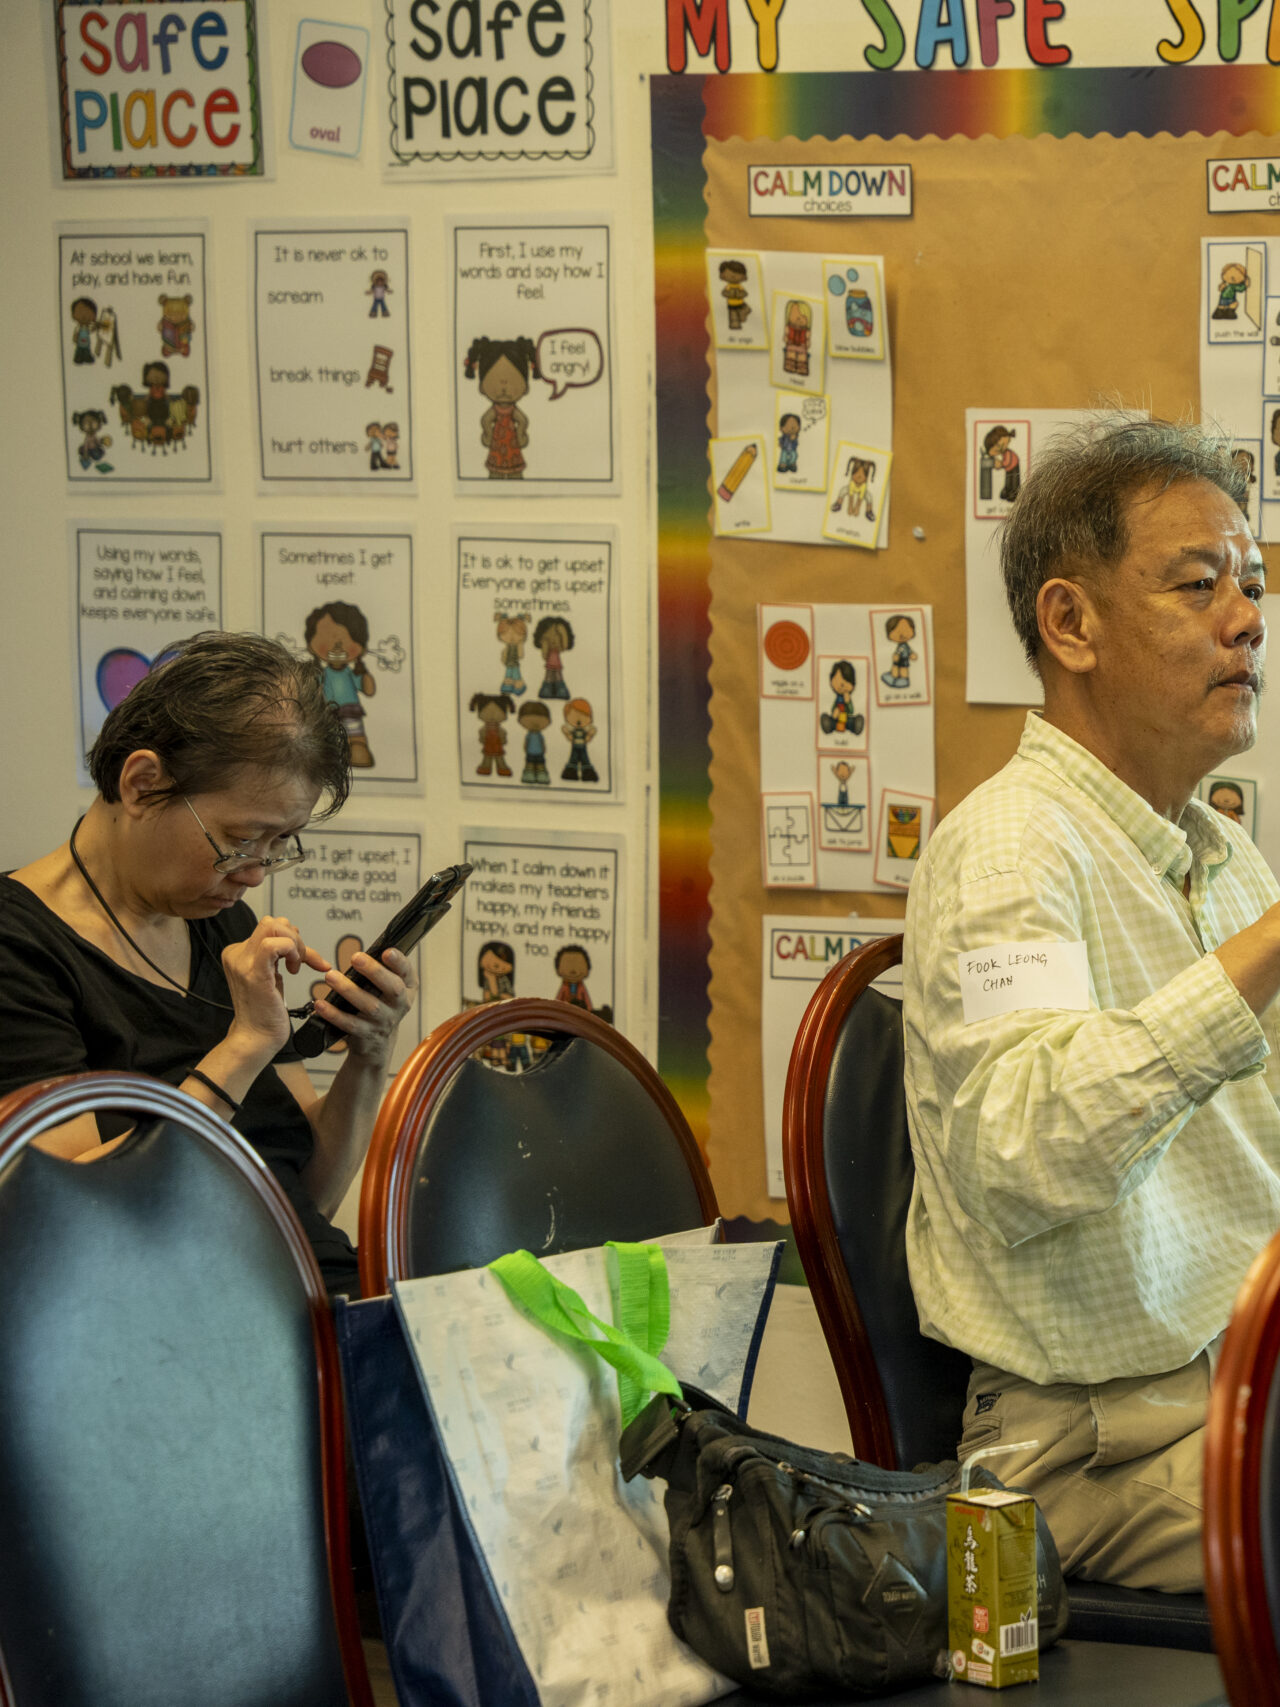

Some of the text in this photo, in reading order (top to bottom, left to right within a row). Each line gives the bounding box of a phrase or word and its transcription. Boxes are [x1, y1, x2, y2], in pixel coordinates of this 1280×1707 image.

[410, 0, 567, 61] safe
[665, 0, 787, 73] MY
[861, 0, 1072, 71] SAFE
[80, 10, 229, 75] safe
[403, 75, 577, 141] place
[75, 88, 241, 154] place
[309, 126, 341, 142] oval
[753, 169, 906, 197] CALM DOWN
[803, 198, 852, 212] choices
[71, 250, 86, 265] At
[90, 250, 132, 266] school
[136, 253, 154, 265] we
[275, 245, 389, 263] It is never ok to
[519, 241, 527, 259] I
[531, 244, 556, 259] use
[560, 245, 583, 261] my
[105, 270, 129, 286] and
[132, 270, 163, 286] have
[460, 261, 604, 282] words and say how I
[267, 290, 324, 304] scream
[550, 339, 586, 355] I feel
[270, 365, 361, 387] break things
[271, 436, 359, 454] hurt others
[96, 544, 131, 566] Using
[134, 548, 155, 564] my
[279, 547, 393, 569] Sometimes I get
[462, 552, 476, 569] It
[482, 553, 492, 569] is
[496, 553, 512, 569] ok
[518, 554, 534, 570] to
[537, 556, 560, 575] get
[93, 566, 133, 585] saying
[136, 566, 163, 581] how
[167, 565, 174, 582] I
[462, 572, 526, 592] Everyone
[530, 576, 561, 594] gets
[93, 584, 206, 606] and calming down
[80, 602, 119, 622] keeps
[122, 606, 182, 624] everyone
[320, 844, 327, 862] I
[331, 847, 353, 864] get
[403, 847, 411, 864] I
[294, 866, 397, 885] can make good
[471, 857, 610, 880] When I calm down it
[288, 886, 402, 904] choices and calm
[470, 878, 610, 900] makes my teachers
[524, 902, 548, 918] my
[551, 901, 601, 919] friends
[513, 921, 539, 936] and
[543, 923, 564, 937] me
[568, 923, 611, 944] happy
[776, 935, 843, 962] CALM
[966, 953, 1048, 974] FOOK LEONG
[983, 975, 1013, 992] CHAN
